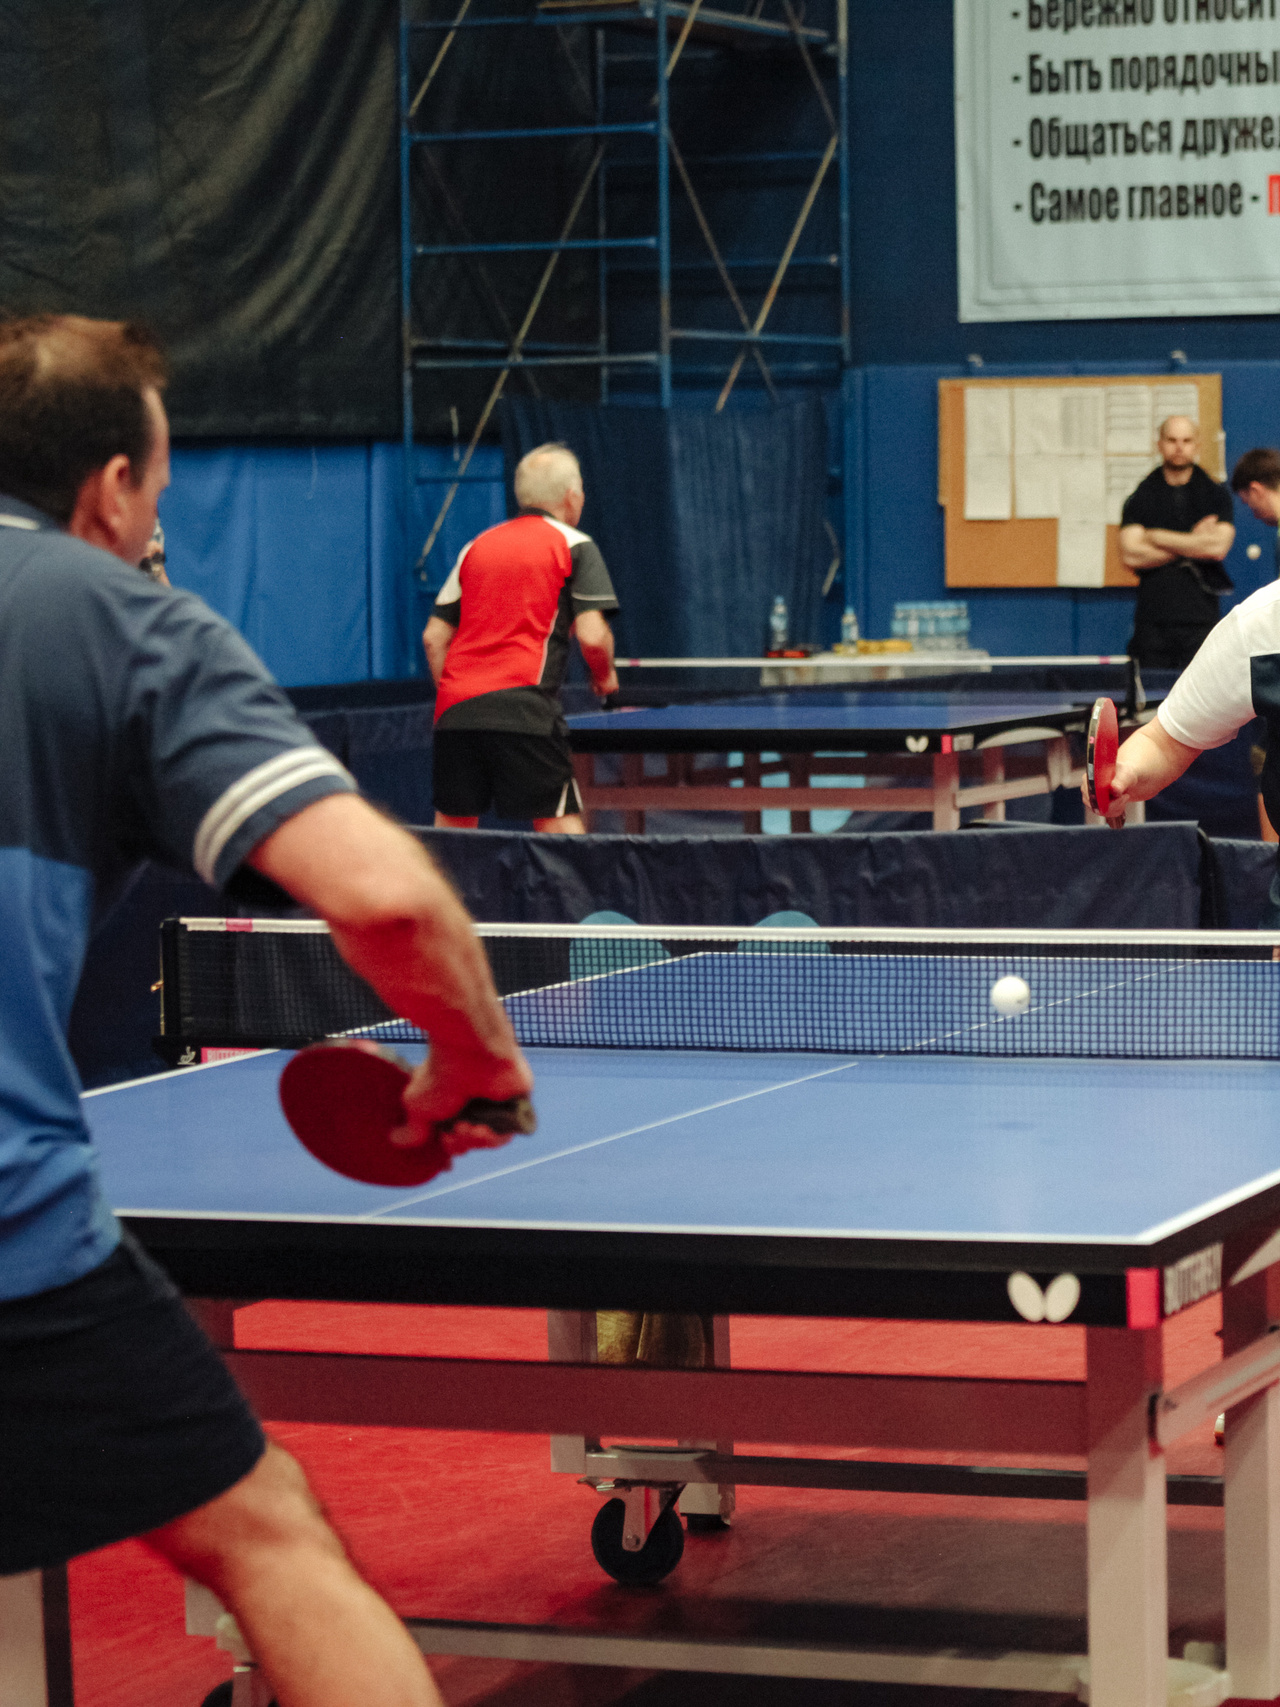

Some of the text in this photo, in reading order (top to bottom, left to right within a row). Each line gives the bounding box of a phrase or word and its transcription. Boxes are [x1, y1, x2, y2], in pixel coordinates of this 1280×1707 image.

[1028, 0, 1154, 34] Бережно
[1028, 53, 1102, 94] Быть
[1029, 116, 1173, 164] Общаться
[1030, 182, 1120, 224] Самое
[1127, 182, 1243, 220] главное
